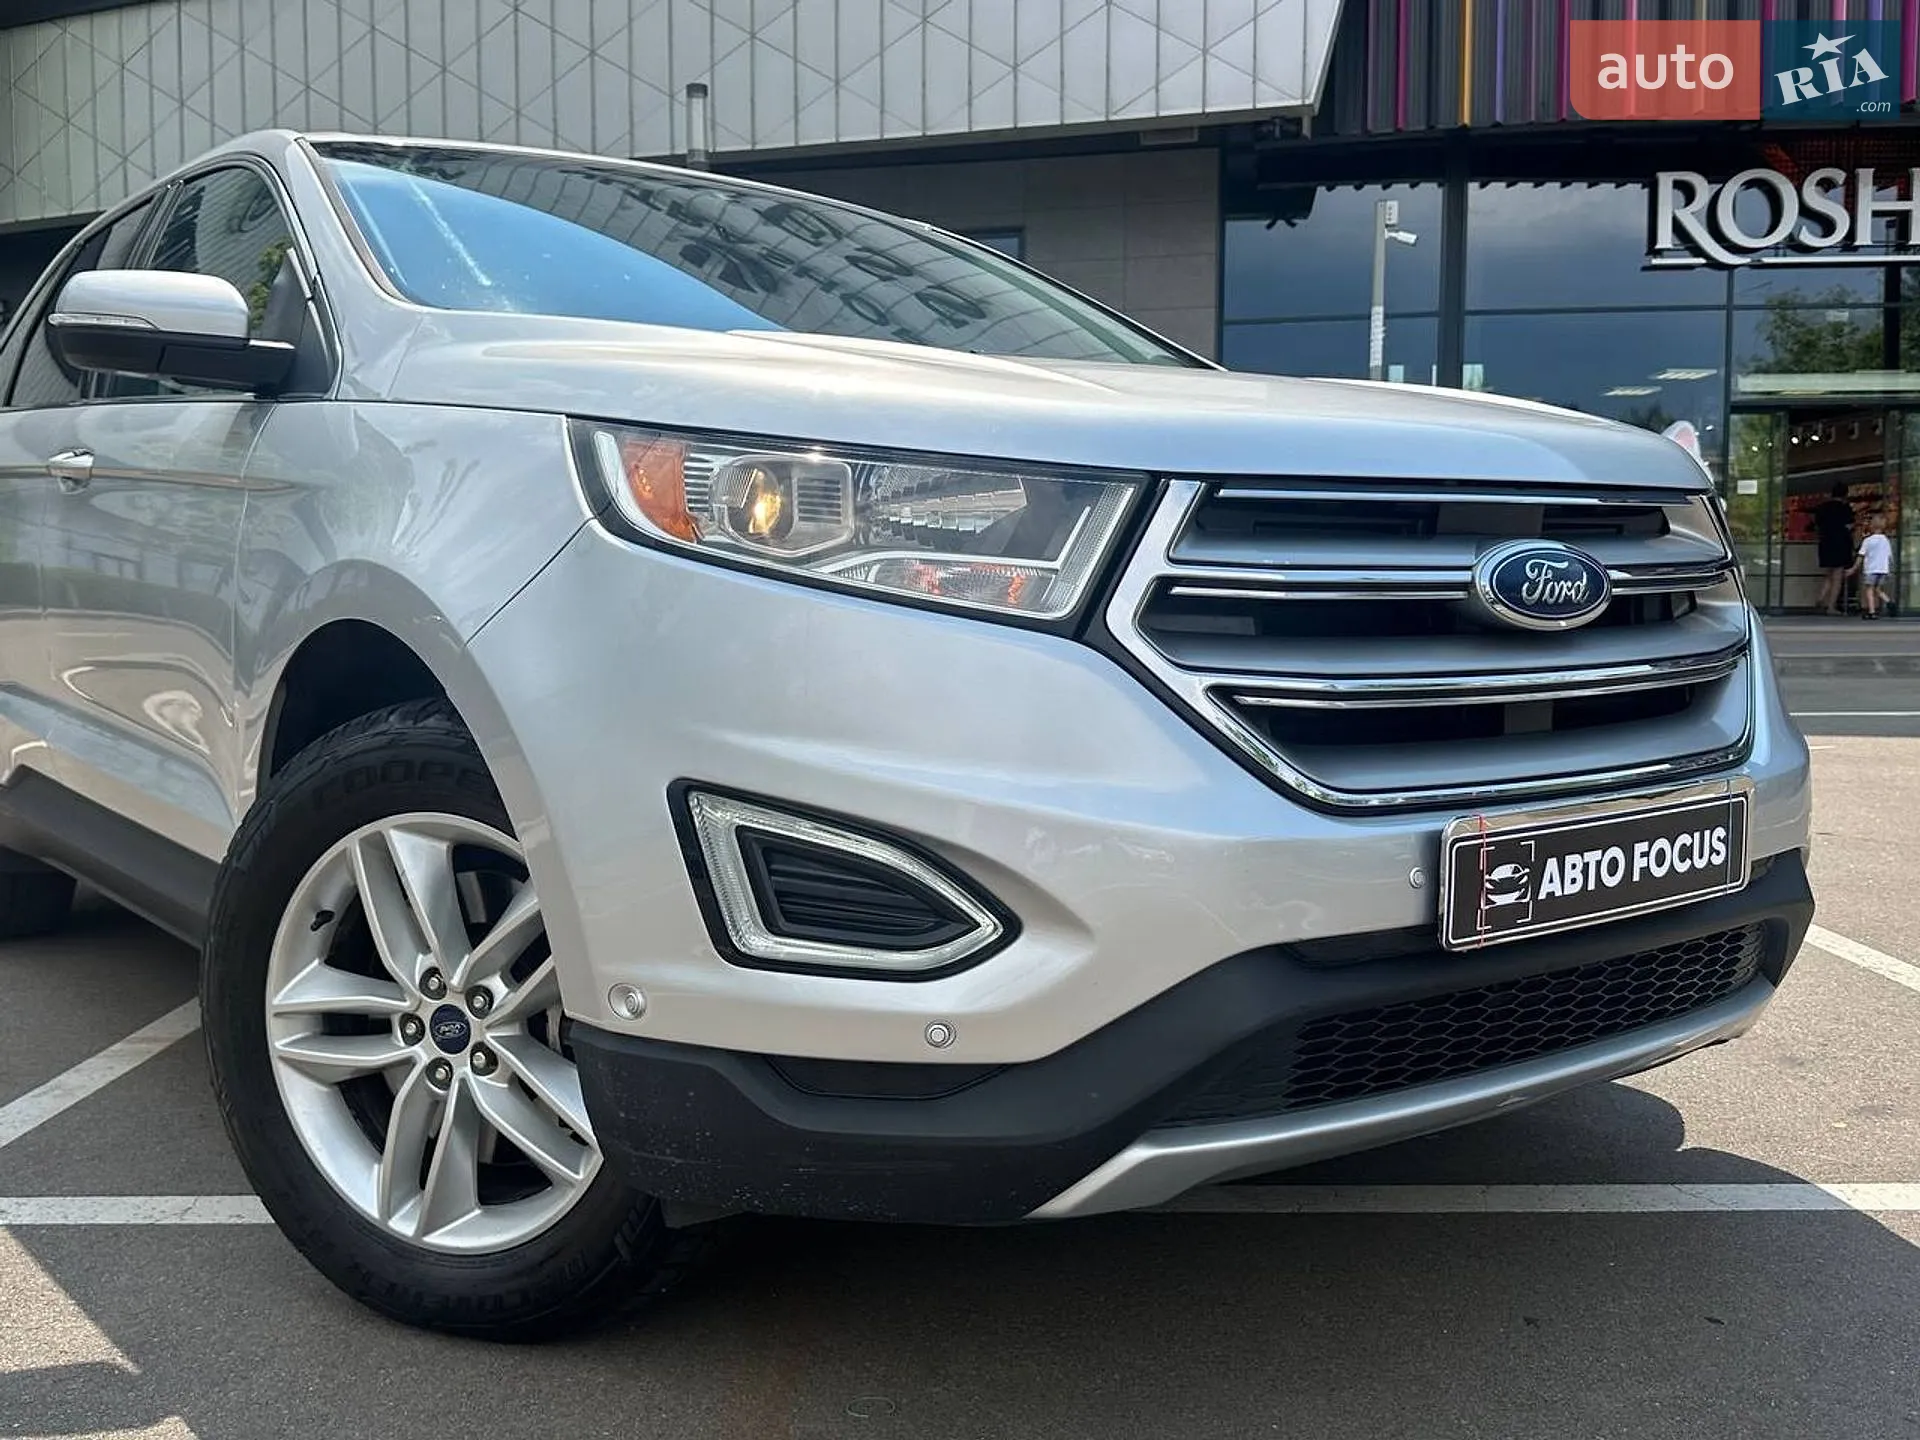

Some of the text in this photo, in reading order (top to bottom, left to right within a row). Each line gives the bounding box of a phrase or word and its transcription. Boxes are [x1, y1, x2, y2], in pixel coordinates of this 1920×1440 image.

[1654, 167, 1920, 265] ROSH
[1521, 558, 1590, 606] Ford
[1632, 826, 1727, 882] FOCUS
